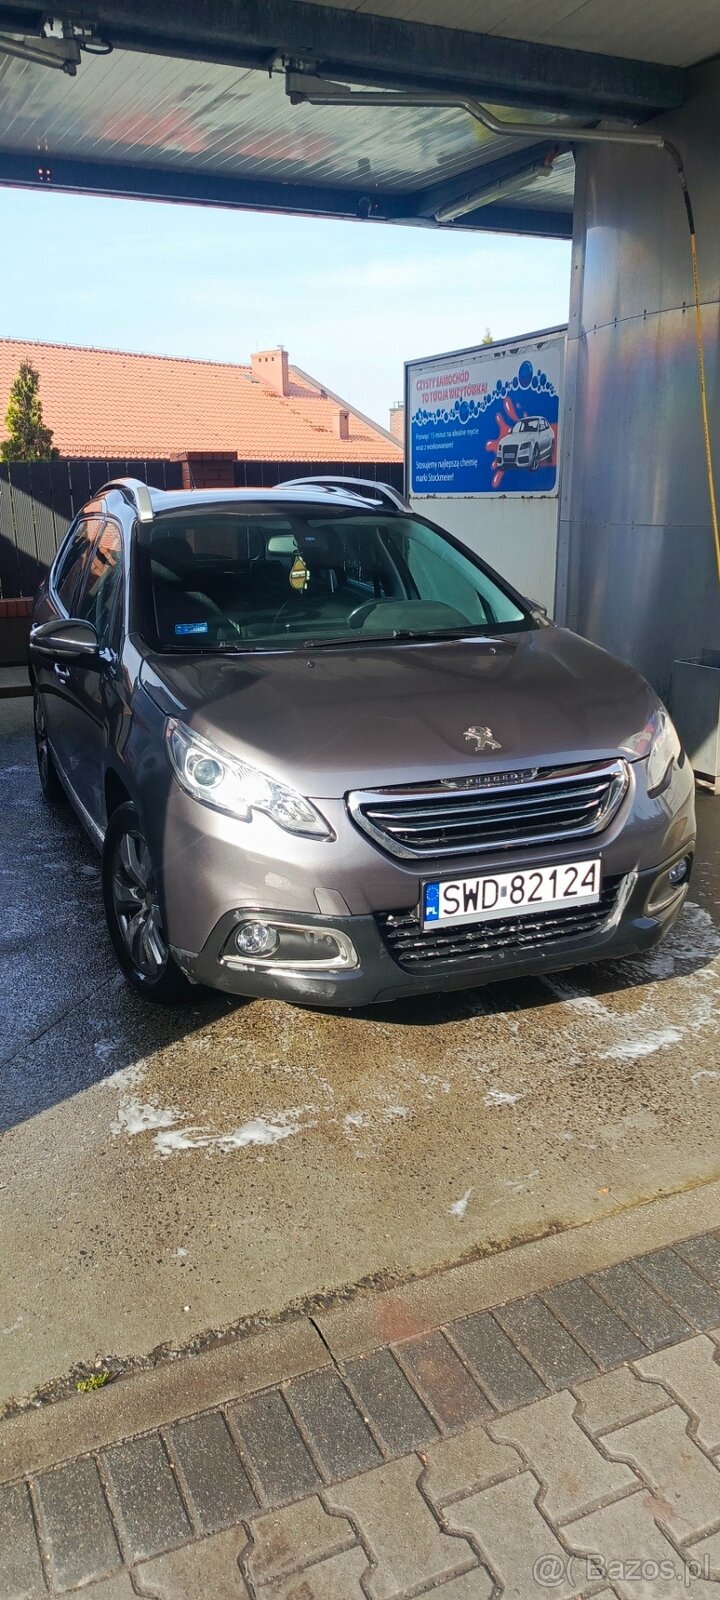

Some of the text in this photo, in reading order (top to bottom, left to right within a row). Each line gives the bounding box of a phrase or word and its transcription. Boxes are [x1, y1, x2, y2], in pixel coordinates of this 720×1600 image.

[416, 369, 470, 391] CZYSTY SAMOCHÓD
[422, 382, 488, 404] TO TWOJA WIZYTÓWKA!
[415, 460, 437, 471] Stosujemy
[443, 863, 596, 914] SWD 82124
[426, 907, 438, 916] PL
